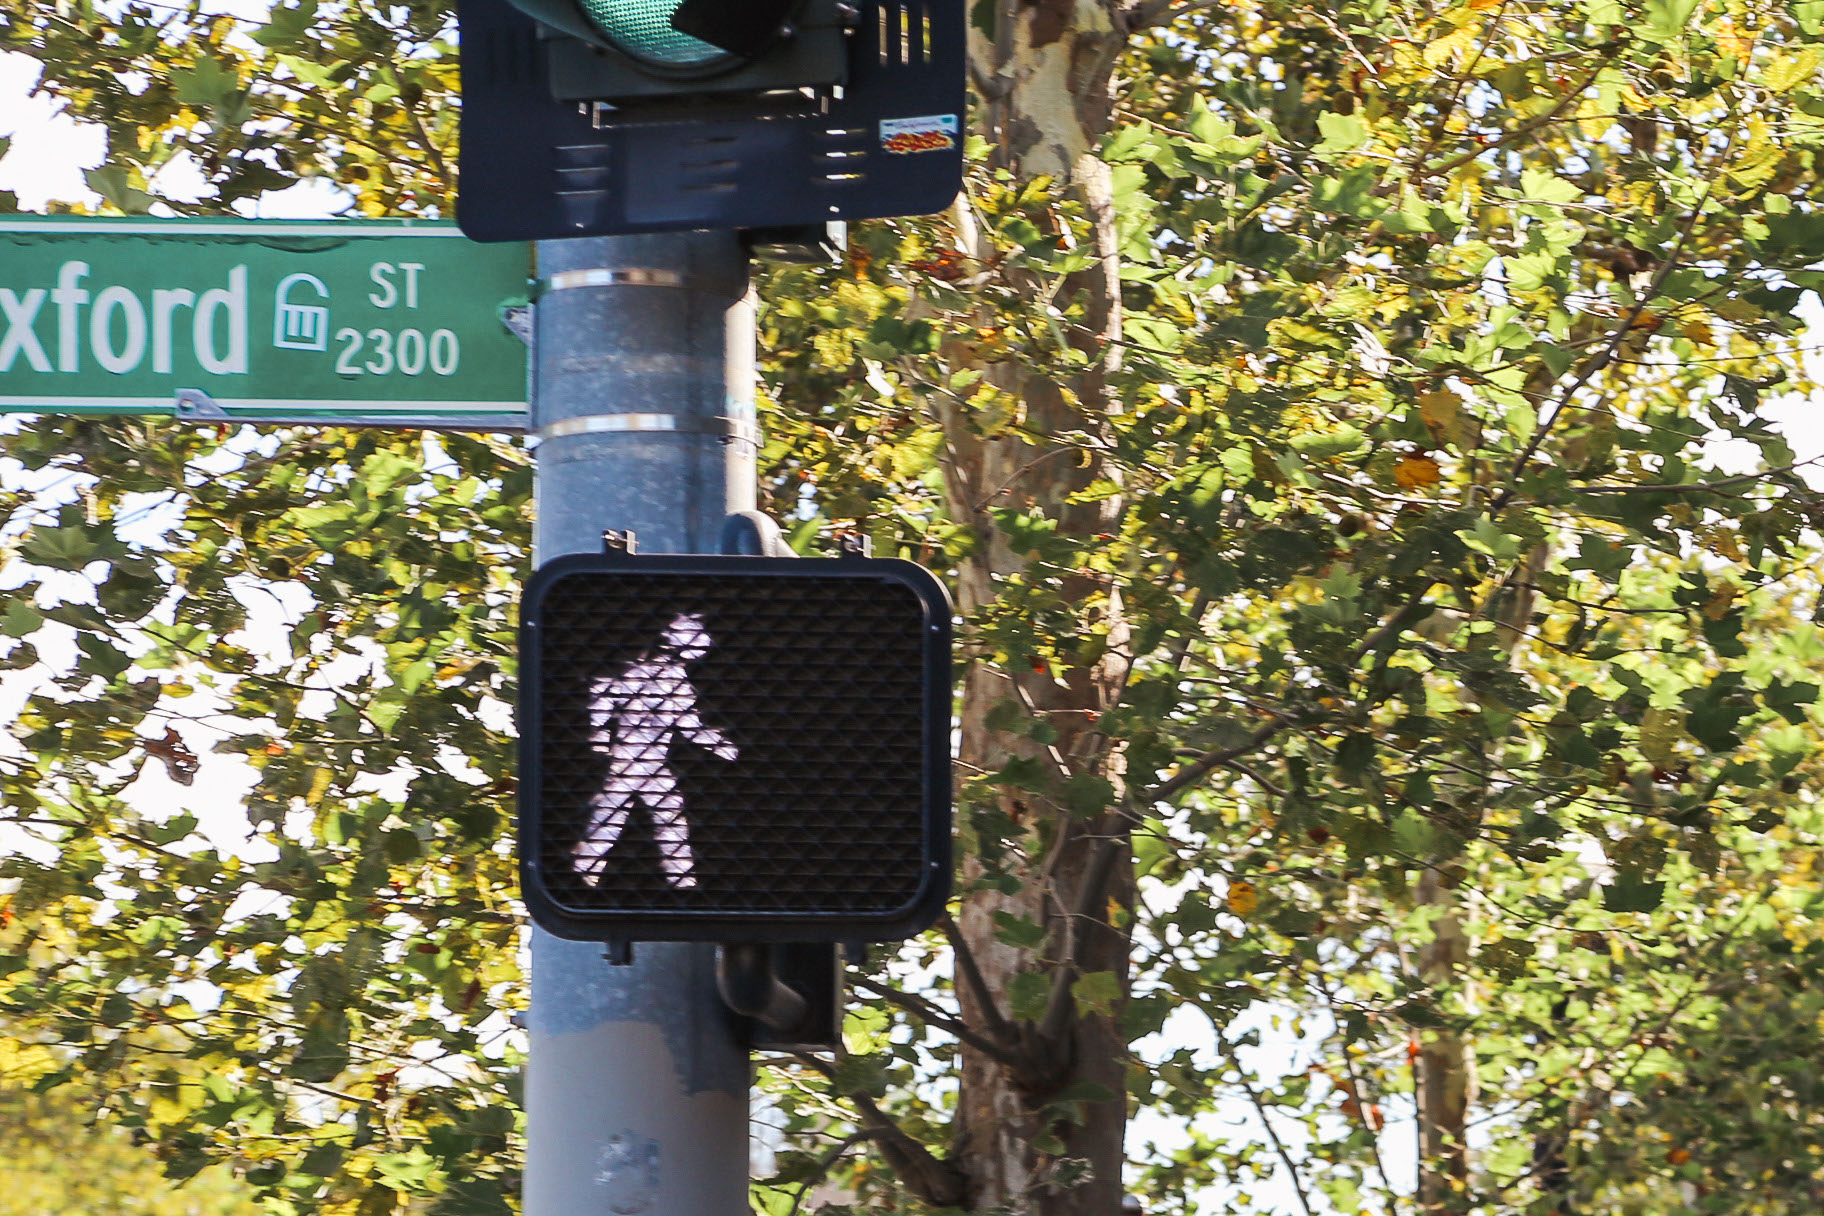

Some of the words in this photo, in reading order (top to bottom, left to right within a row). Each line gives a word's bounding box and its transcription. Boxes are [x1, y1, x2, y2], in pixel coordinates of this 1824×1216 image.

[368, 262, 426, 309] ST
[0, 260, 249, 375] xford
[334, 327, 460, 377] 2300
